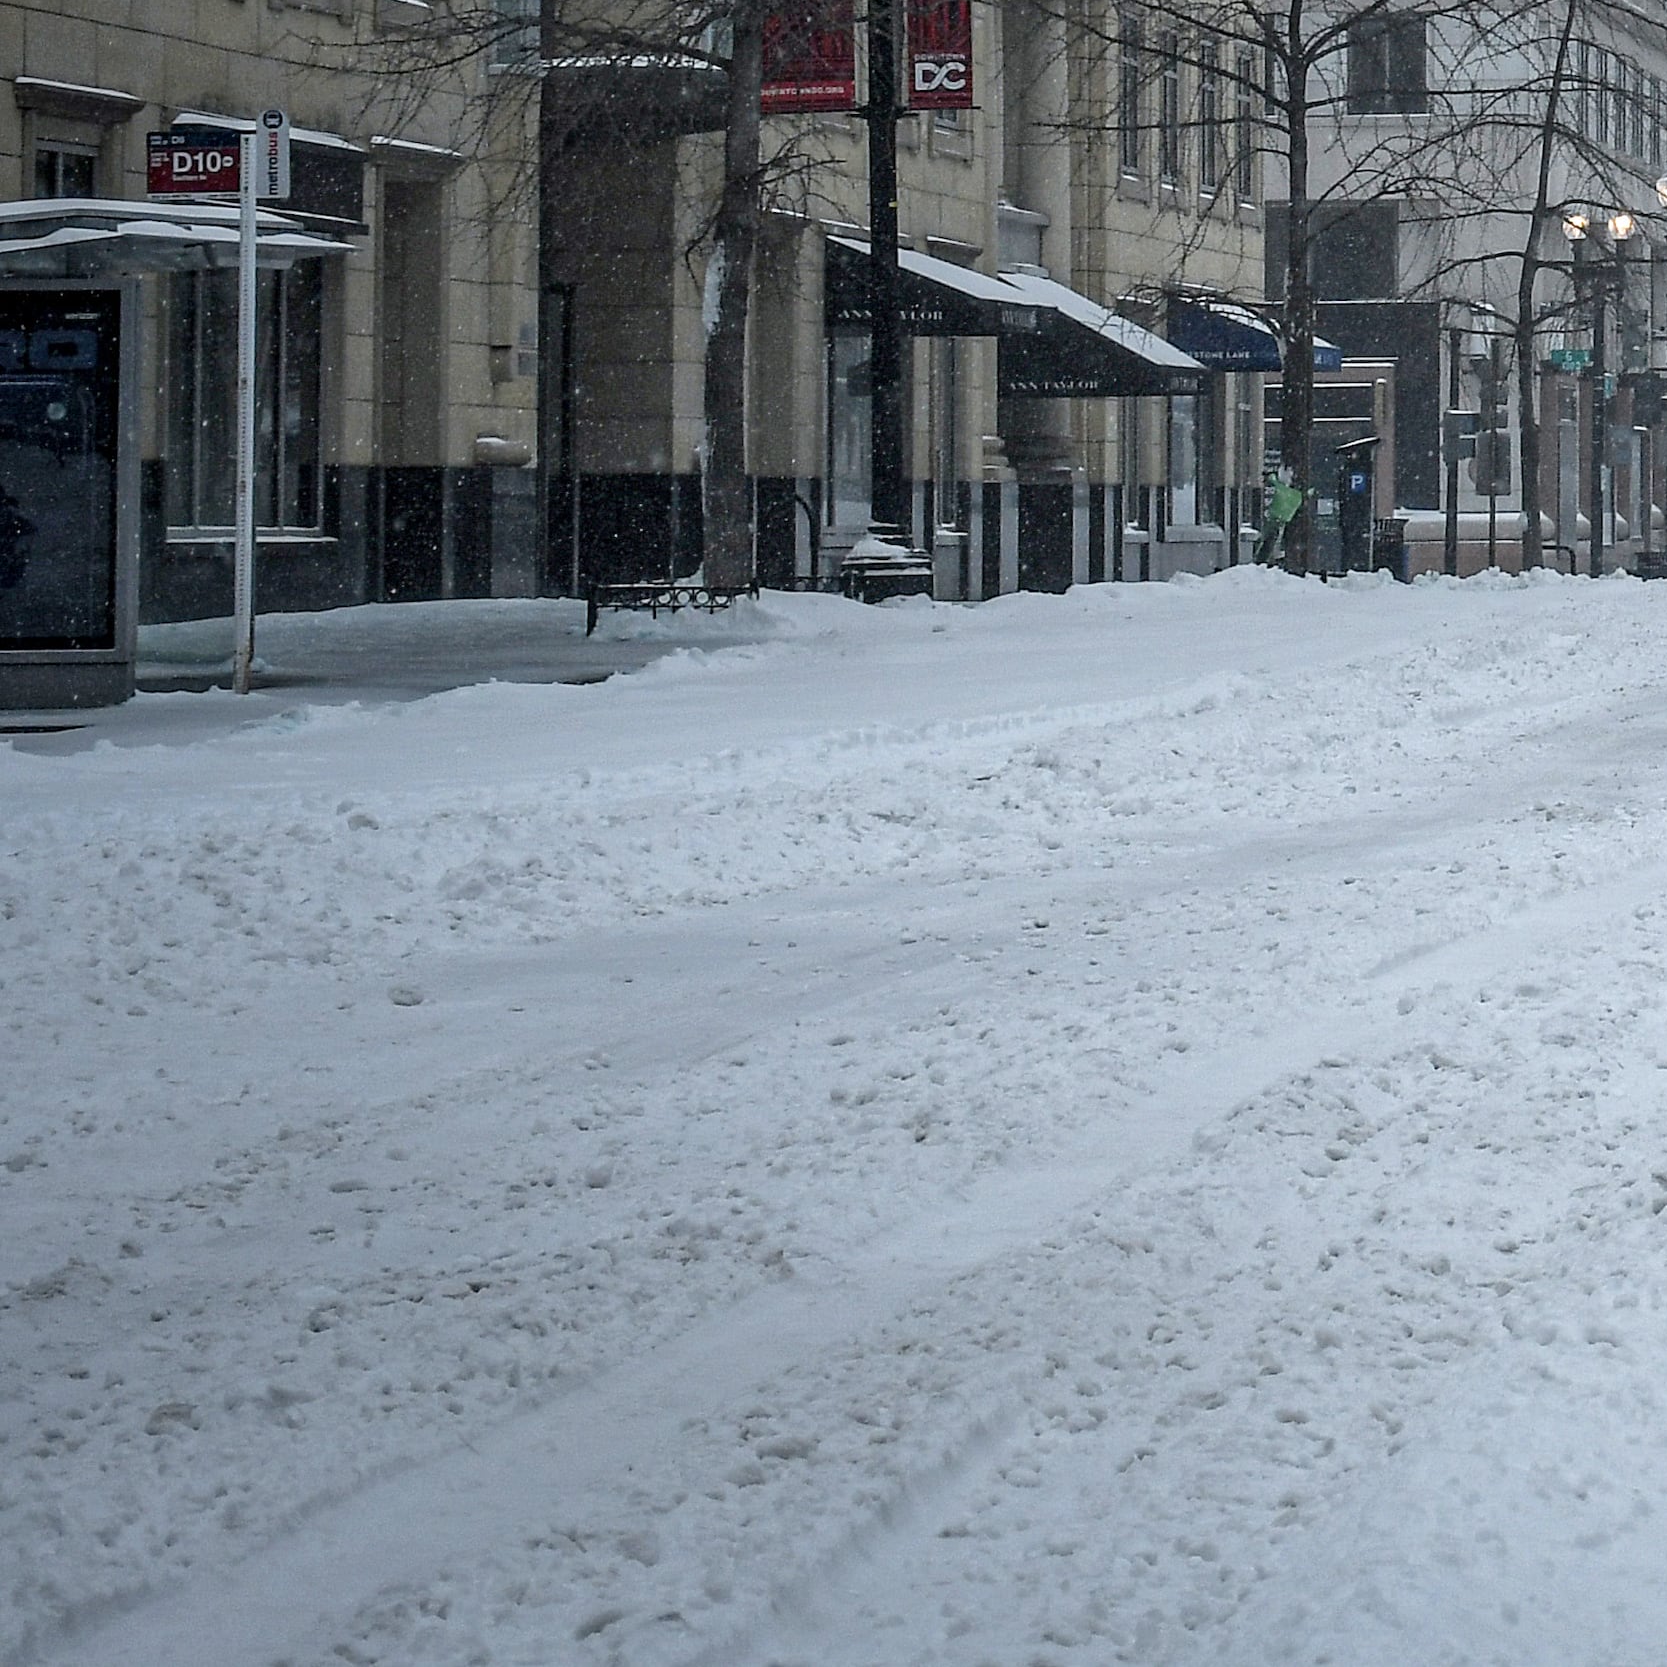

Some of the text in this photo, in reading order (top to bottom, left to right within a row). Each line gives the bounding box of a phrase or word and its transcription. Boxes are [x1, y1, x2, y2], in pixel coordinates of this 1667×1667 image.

[914, 62, 966, 91] DC
[172, 151, 221, 173] D10
[268, 132, 279, 194] metrobus
[900, 310, 943, 320] YLOR
[1351, 475, 1364, 490] P
